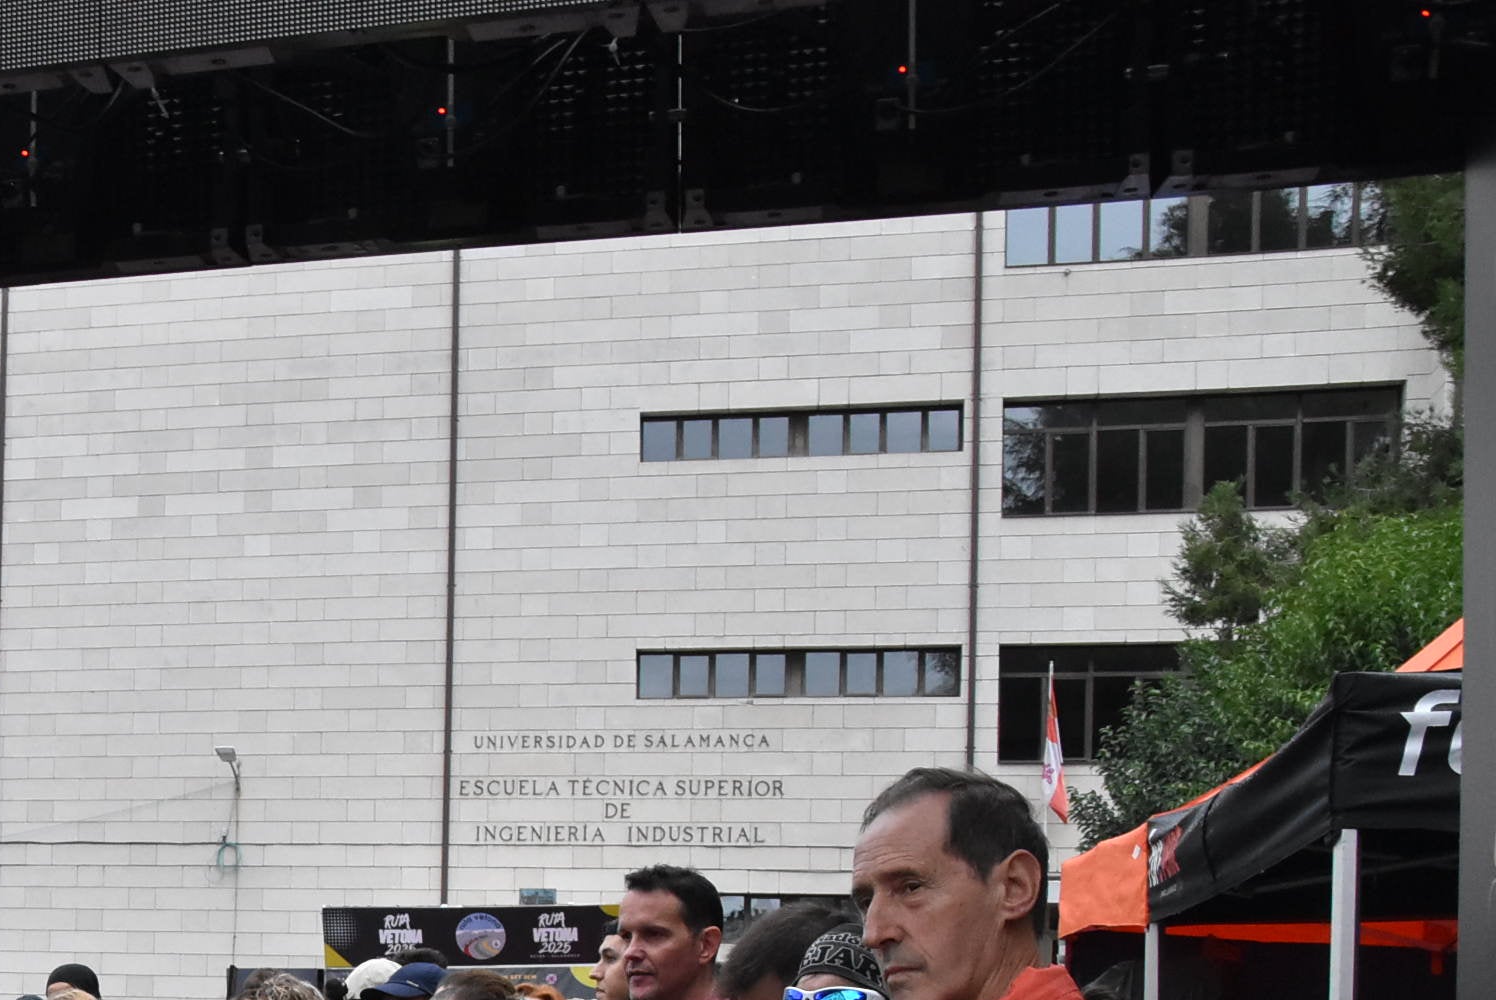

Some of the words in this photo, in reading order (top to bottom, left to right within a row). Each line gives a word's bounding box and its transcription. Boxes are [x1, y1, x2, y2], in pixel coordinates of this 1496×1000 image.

[474, 734, 605, 749] UNIVERSIDAD
[614, 735, 636, 748] DE
[644, 734, 770, 748] SALAMANCA
[459, 779, 560, 796] ESCUELA
[568, 777, 667, 796] TÉCNICA
[674, 779, 785, 797] SUPERIOR
[604, 802, 631, 819] DE
[476, 824, 605, 842] INGENIERÍA
[627, 825, 766, 843] INDUSTRIAL
[384, 913, 411, 929] RUTA
[538, 912, 566, 928] RUTA
[538, 942, 572, 954] 2025
